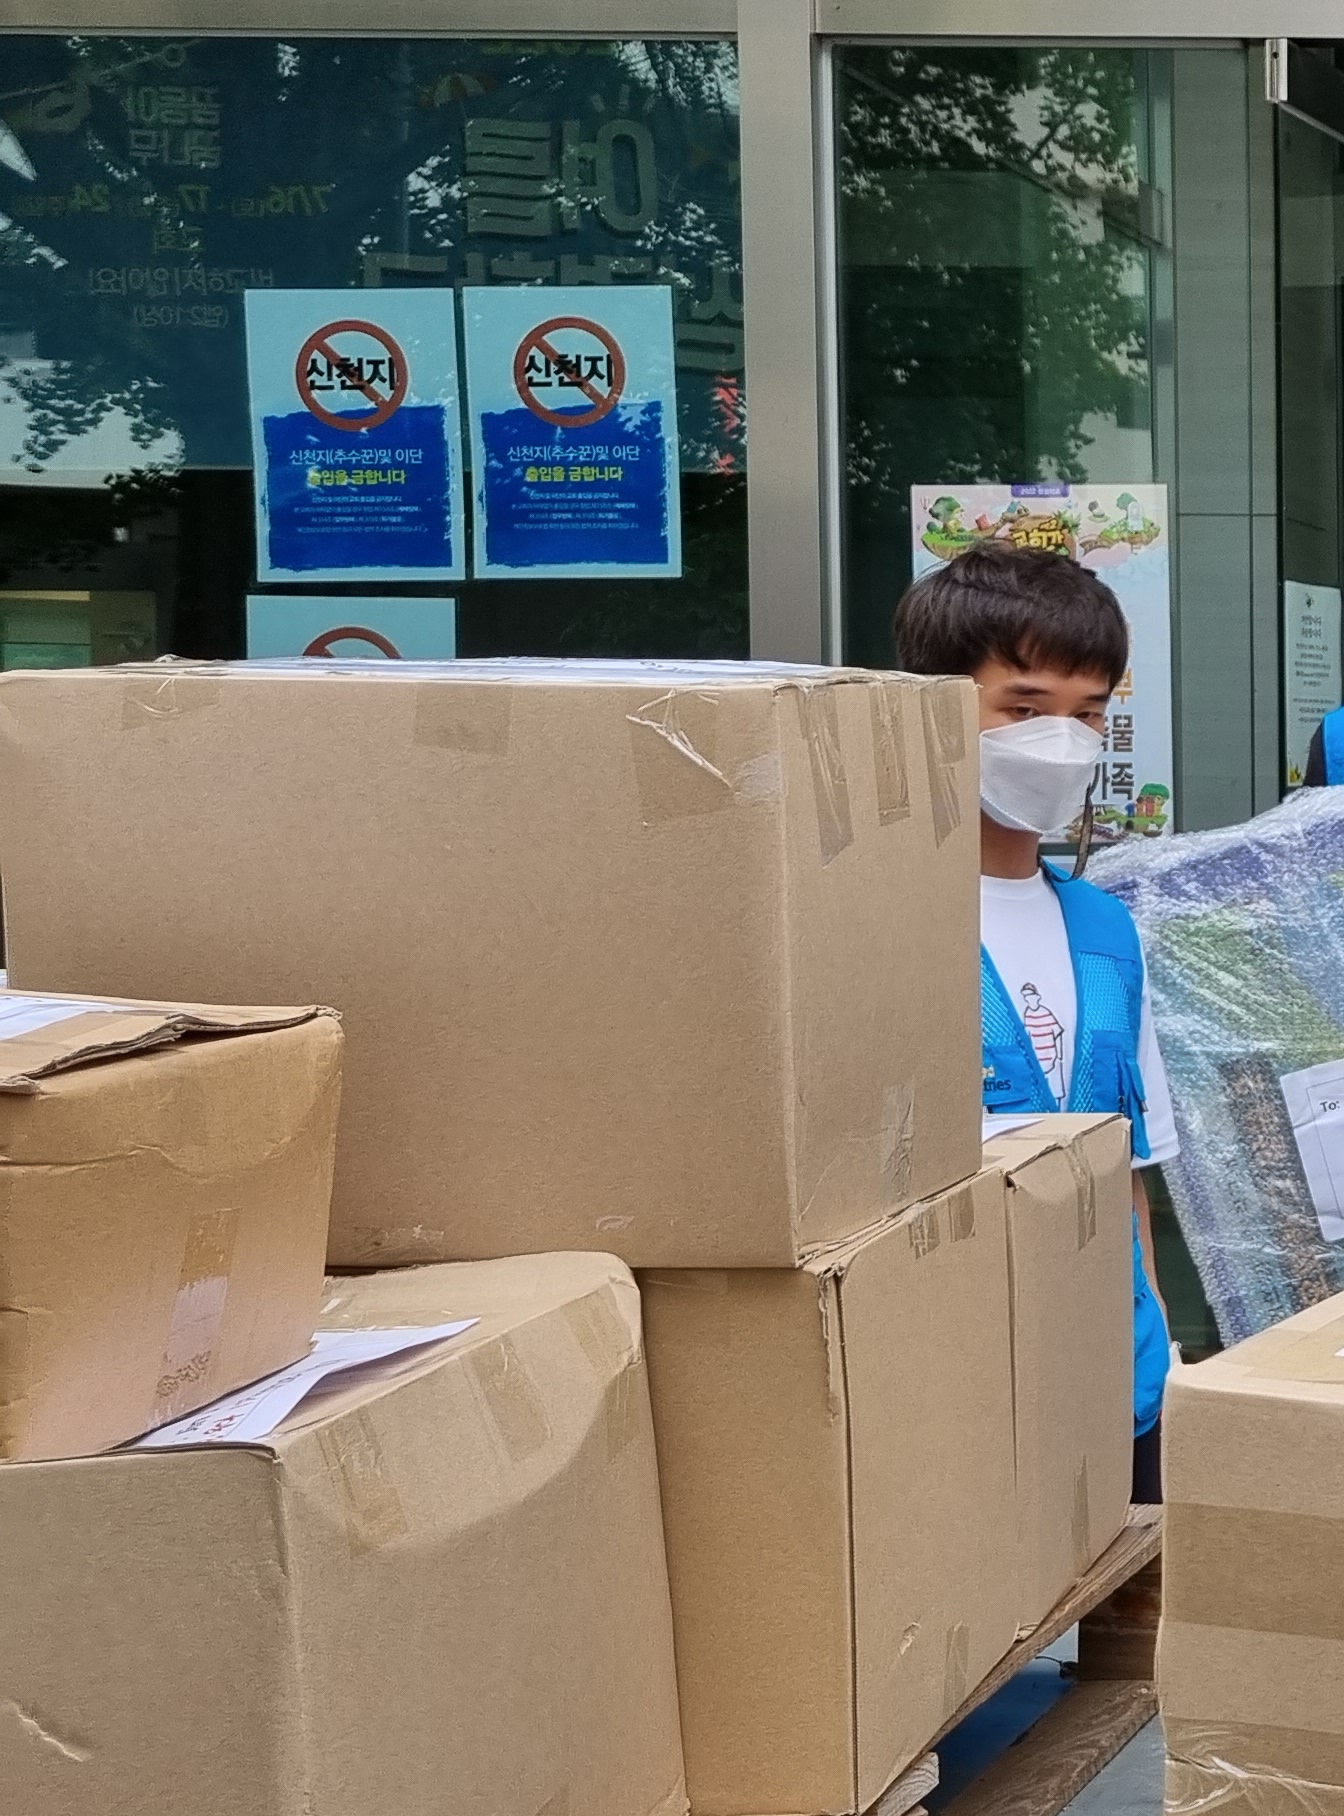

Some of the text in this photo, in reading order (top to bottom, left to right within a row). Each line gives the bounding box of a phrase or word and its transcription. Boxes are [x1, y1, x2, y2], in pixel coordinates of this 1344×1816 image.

[307, 357, 397, 391] 신천지
[525, 353, 613, 388] 신천지
[395, 448, 423, 465] 이단
[612, 445, 640, 461] 이단
[351, 469, 407, 486] 금합니다
[569, 466, 624, 482] 금합니다
[1320, 1100, 1340, 1114] To:
